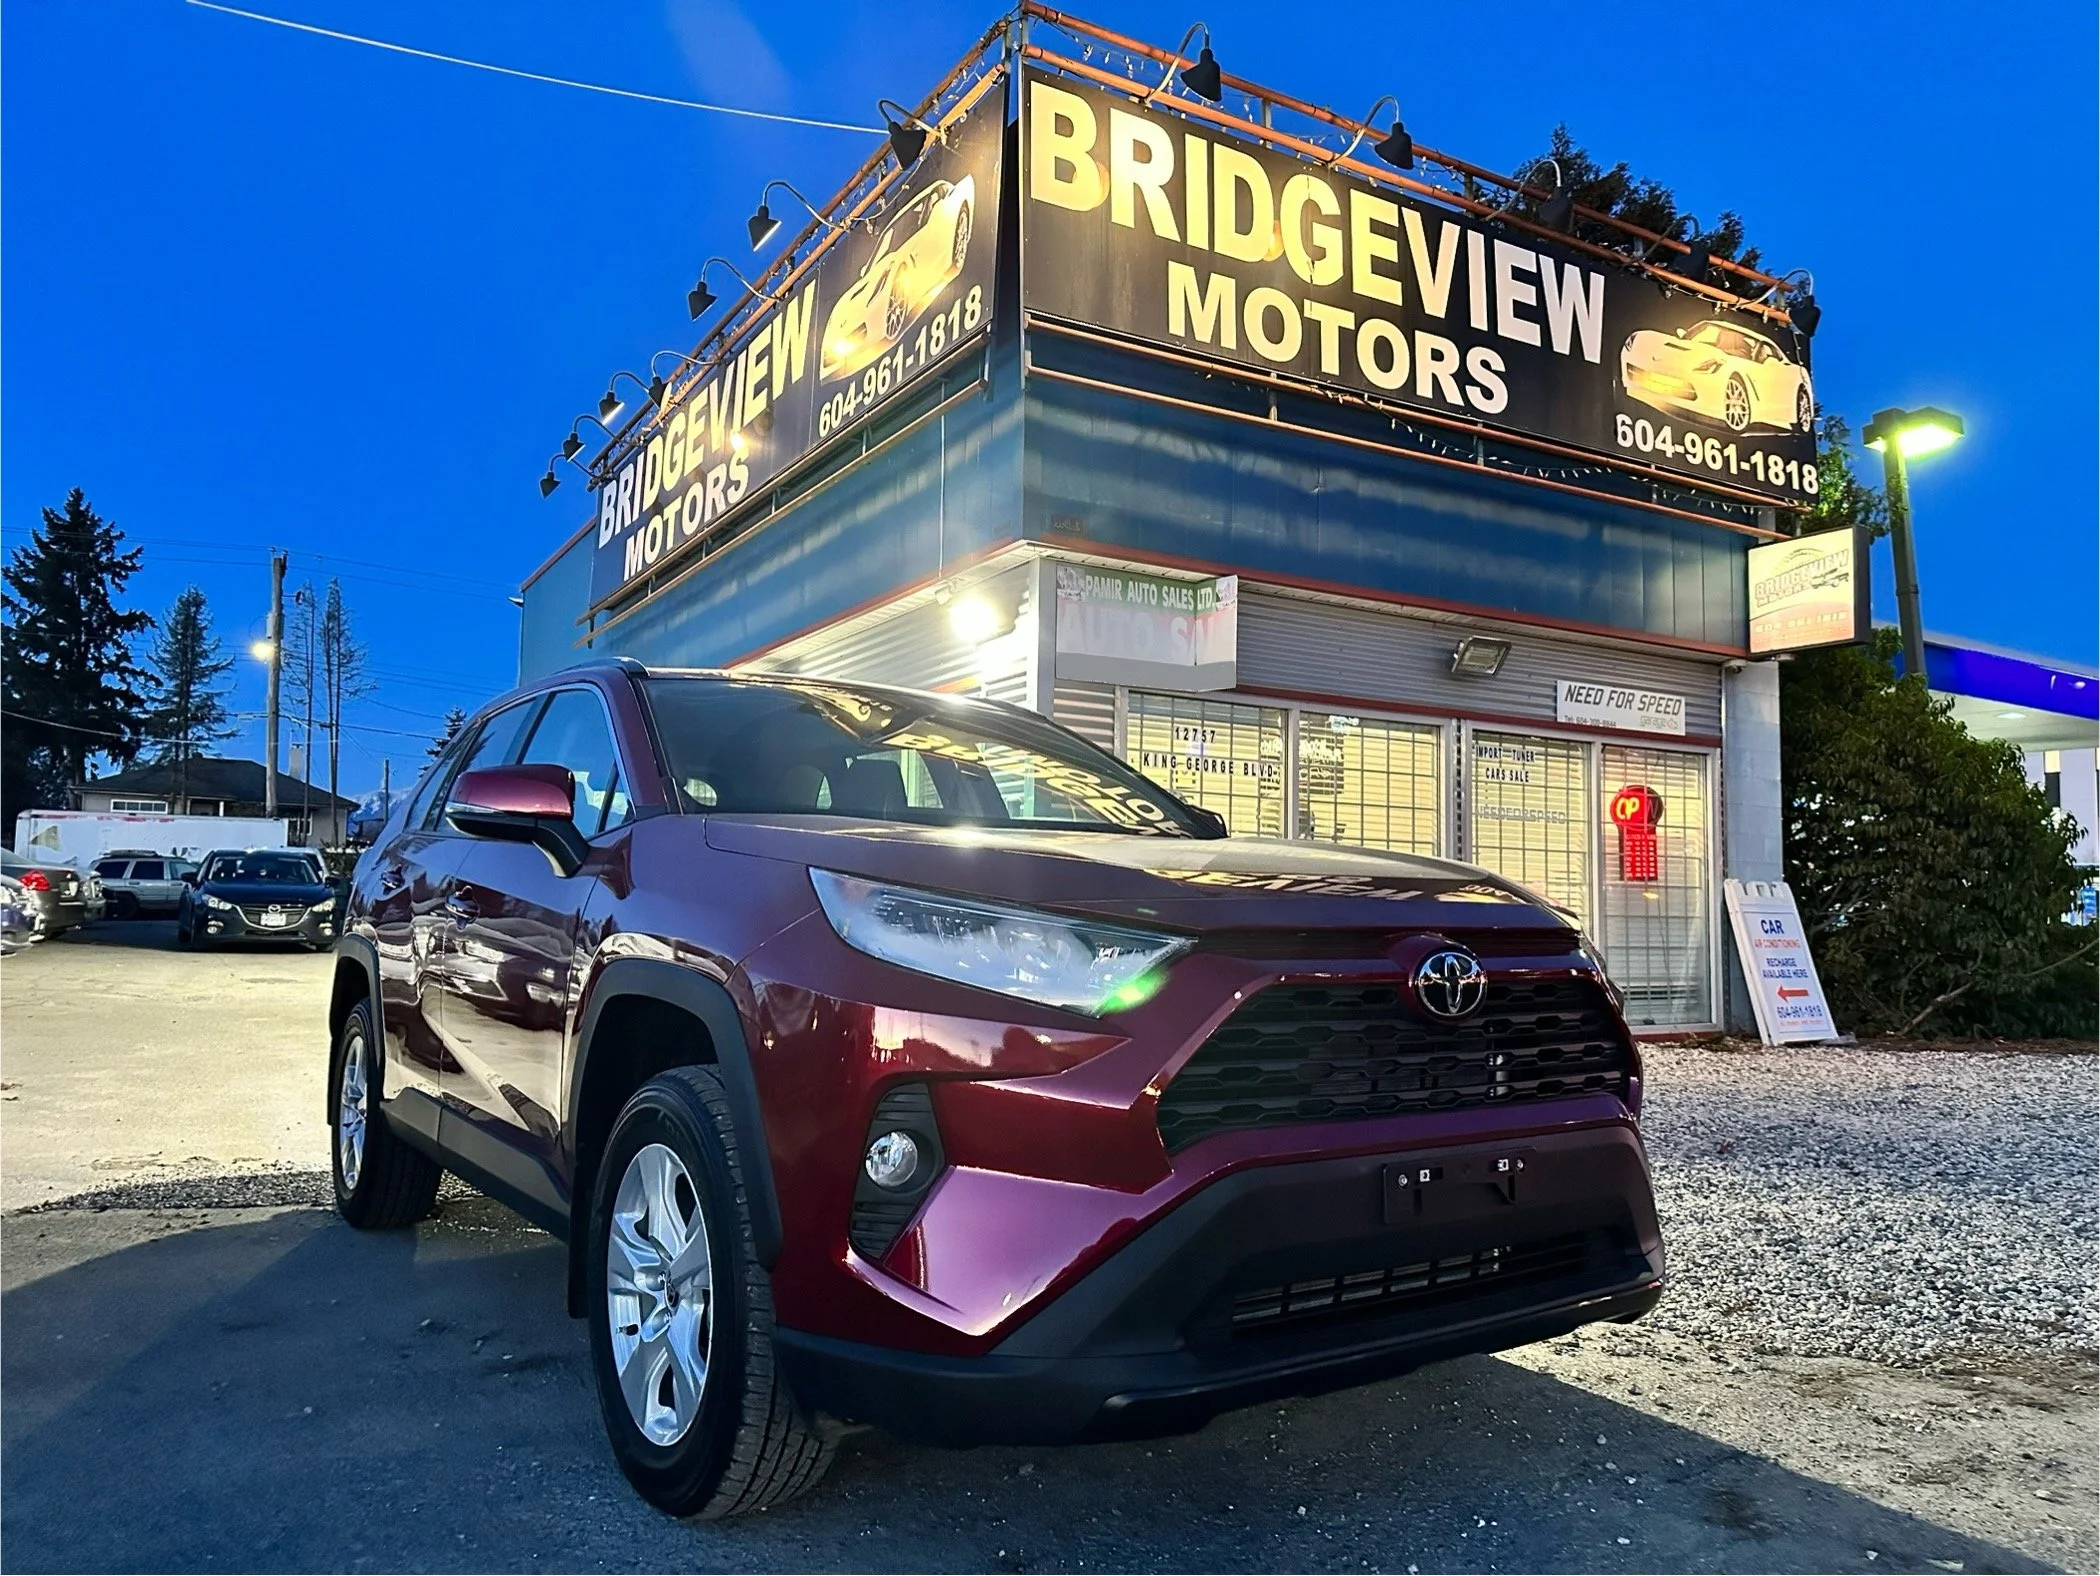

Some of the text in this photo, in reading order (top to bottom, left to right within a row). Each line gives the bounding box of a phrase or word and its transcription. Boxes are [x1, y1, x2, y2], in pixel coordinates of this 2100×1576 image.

[1030, 80, 1606, 364] BRIDGEVIEW
[1167, 261, 1509, 415] MOTORS
[818, 284, 983, 438] 604-961-1818
[598, 279, 816, 549] BRIDGEVIEW
[1615, 413, 1820, 495] 604-961-1818
[623, 450, 750, 581] MOTORS
[1084, 575, 1122, 601] PAMIR
[1127, 582, 1157, 606] AUTO
[1162, 586, 1194, 611] SALES
[1565, 684, 1682, 716] NEED FOR SPEED
[1175, 727, 1216, 743] 12757
[1143, 753, 1177, 769] KING
[1186, 757, 1234, 774] GEORGE
[1476, 746, 1535, 763] IMPORT TUNER
[1485, 767, 1529, 783] CARS SALE
[1760, 919, 1785, 934] CAR
[1763, 968, 1809, 978] AVAILABLE HERE
[1766, 957, 1797, 967] RECHARGE
